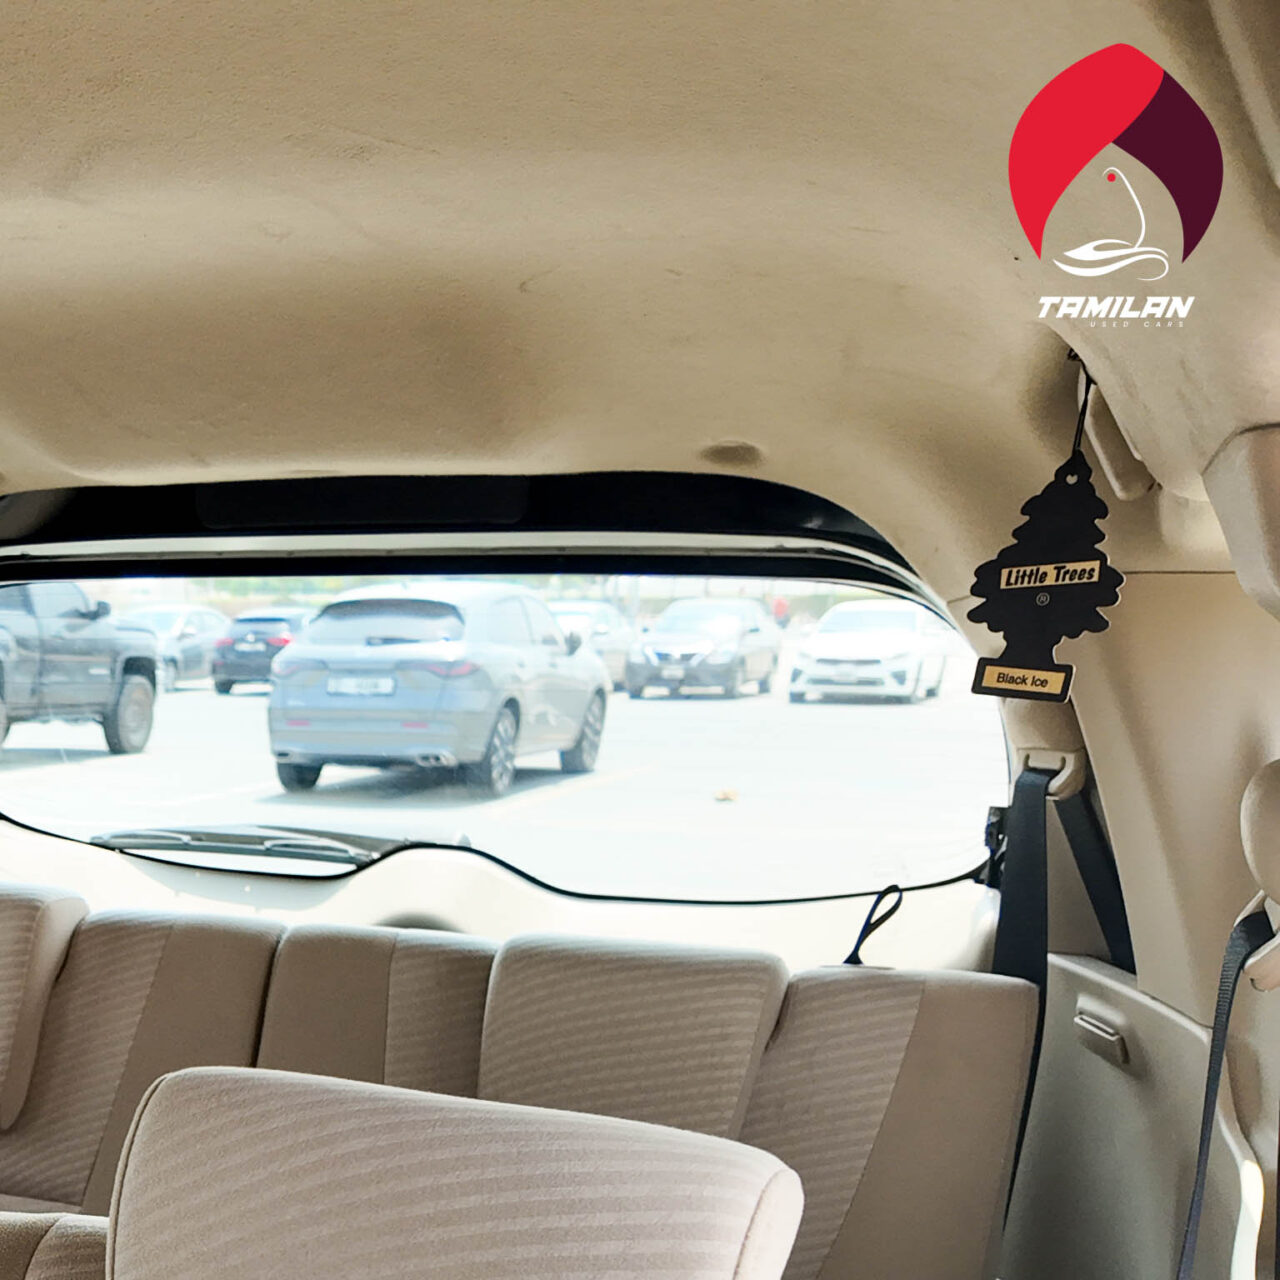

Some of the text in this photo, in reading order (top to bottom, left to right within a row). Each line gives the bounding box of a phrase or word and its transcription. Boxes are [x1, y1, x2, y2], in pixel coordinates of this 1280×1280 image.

[1005, 565, 1095, 586] Little Trees
[996, 672, 1049, 688] Black Ice
